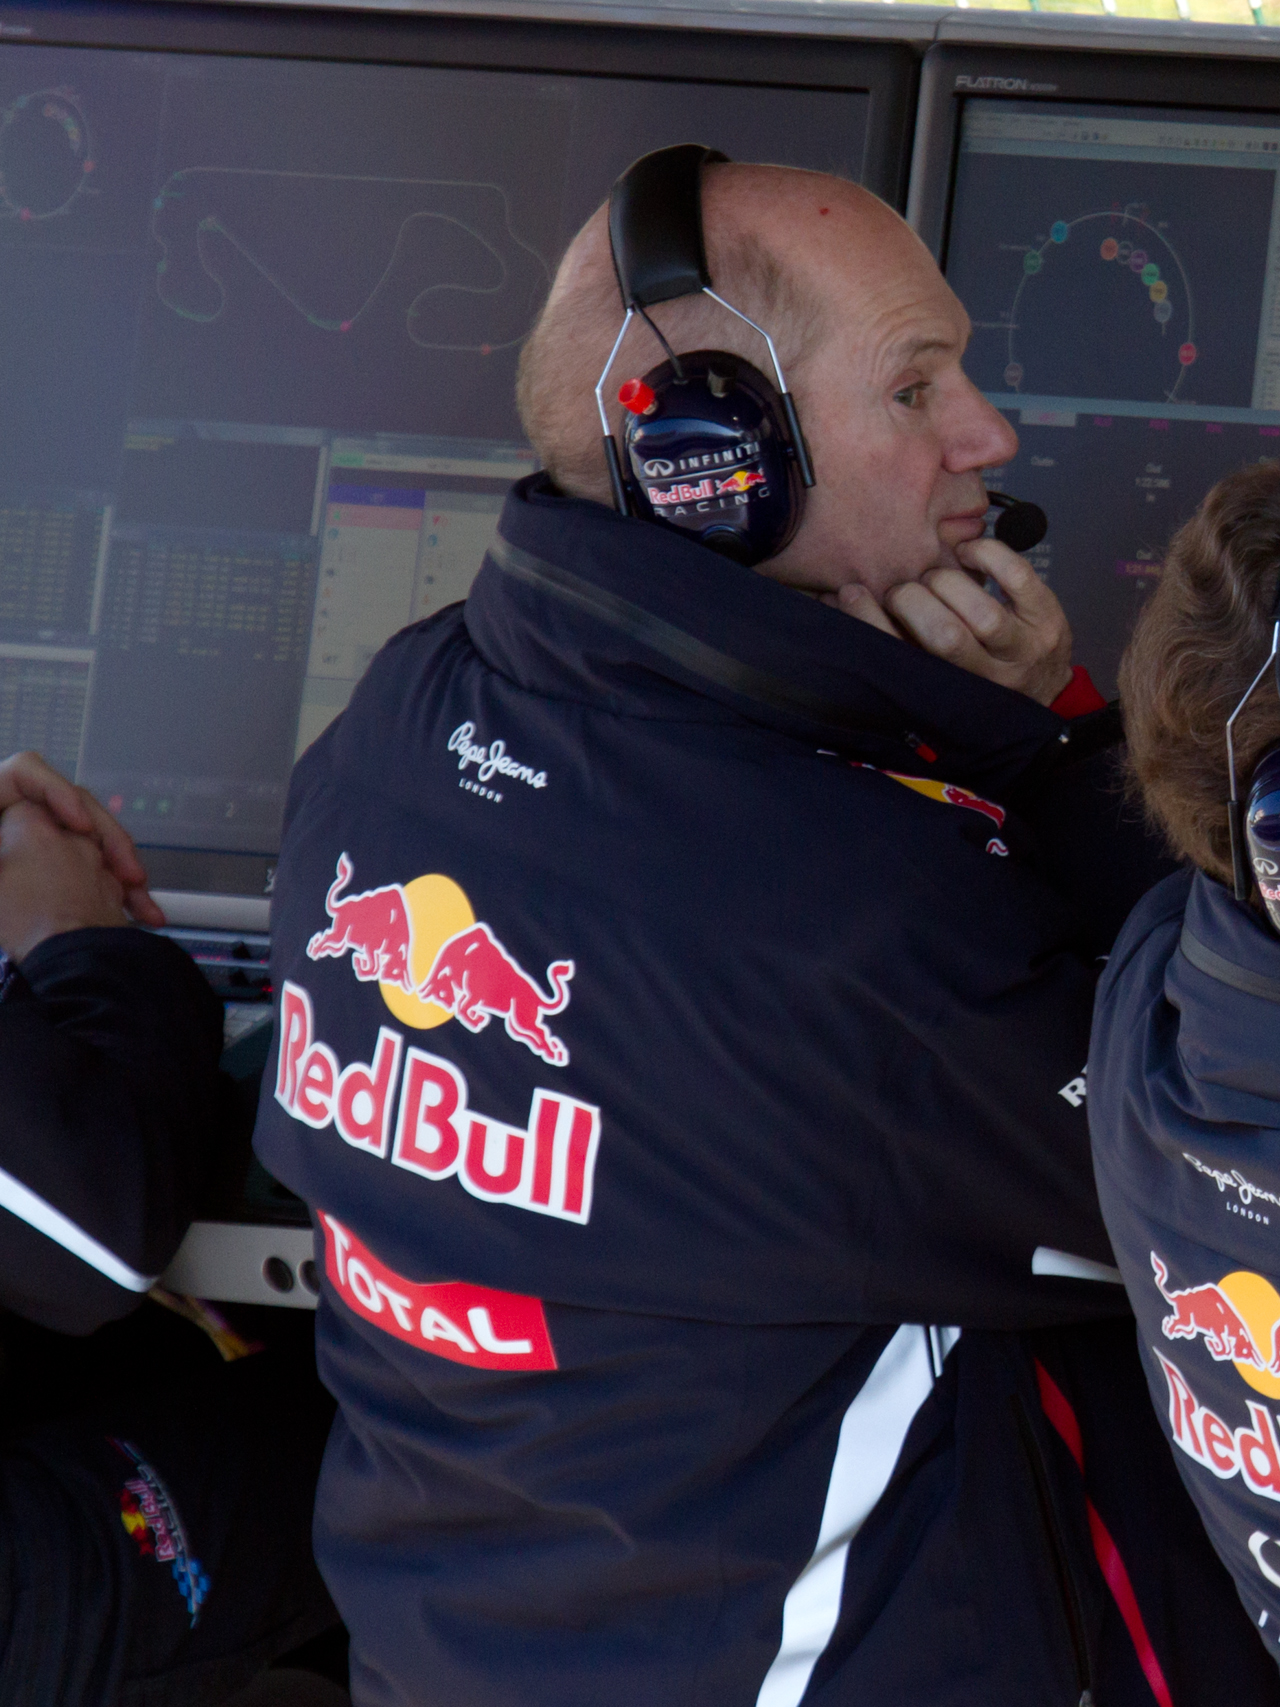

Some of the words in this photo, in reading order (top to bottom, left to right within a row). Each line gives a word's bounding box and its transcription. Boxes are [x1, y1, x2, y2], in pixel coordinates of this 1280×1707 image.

[954, 74, 1028, 91] FLATRON
[678, 441, 761, 471] INFINITI
[653, 486, 771, 518] RACING
[447, 720, 488, 770] Pepe
[477, 739, 549, 789] Jeans
[458, 777, 505, 804] LONDON
[1181, 1152, 1238, 1192] Pepe
[1225, 1201, 1270, 1226] LONDON
[323, 1213, 533, 1354] TOTAL
